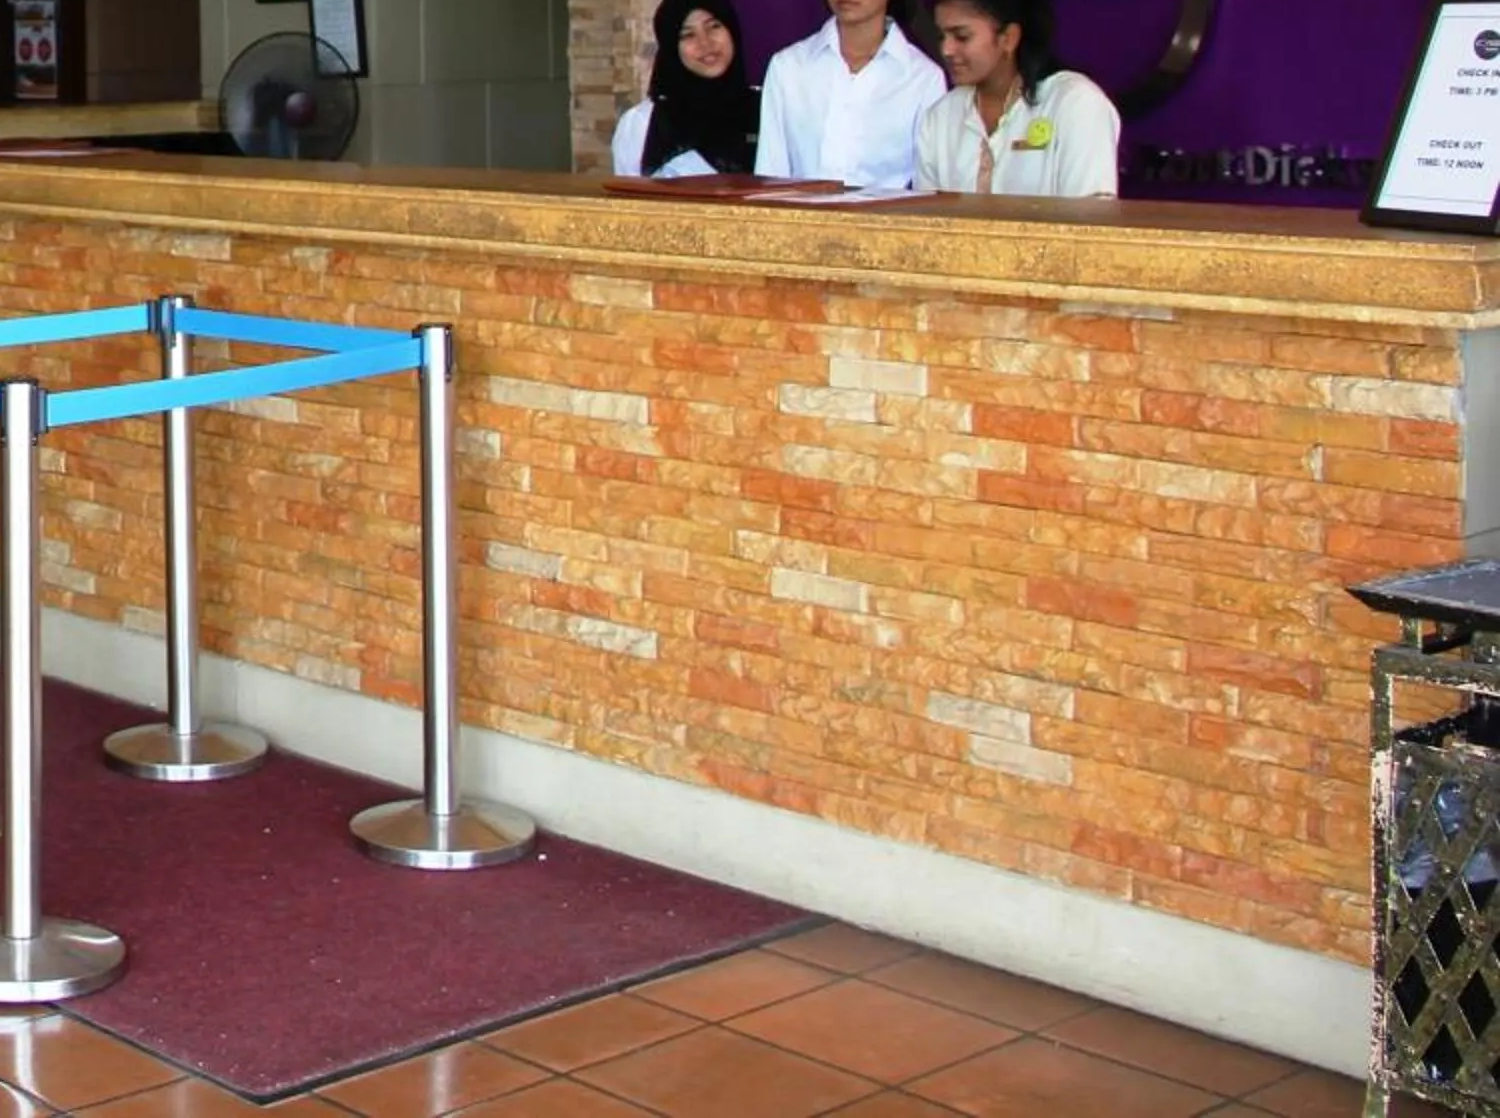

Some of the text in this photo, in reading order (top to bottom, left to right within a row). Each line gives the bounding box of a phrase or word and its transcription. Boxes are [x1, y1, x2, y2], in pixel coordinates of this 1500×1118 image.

[1457, 68, 1488, 78] CHECK
[1429, 139, 1483, 150] CHECK OUT
[1443, 158, 1455, 168] 12
[1455, 158, 1485, 170] NOON
